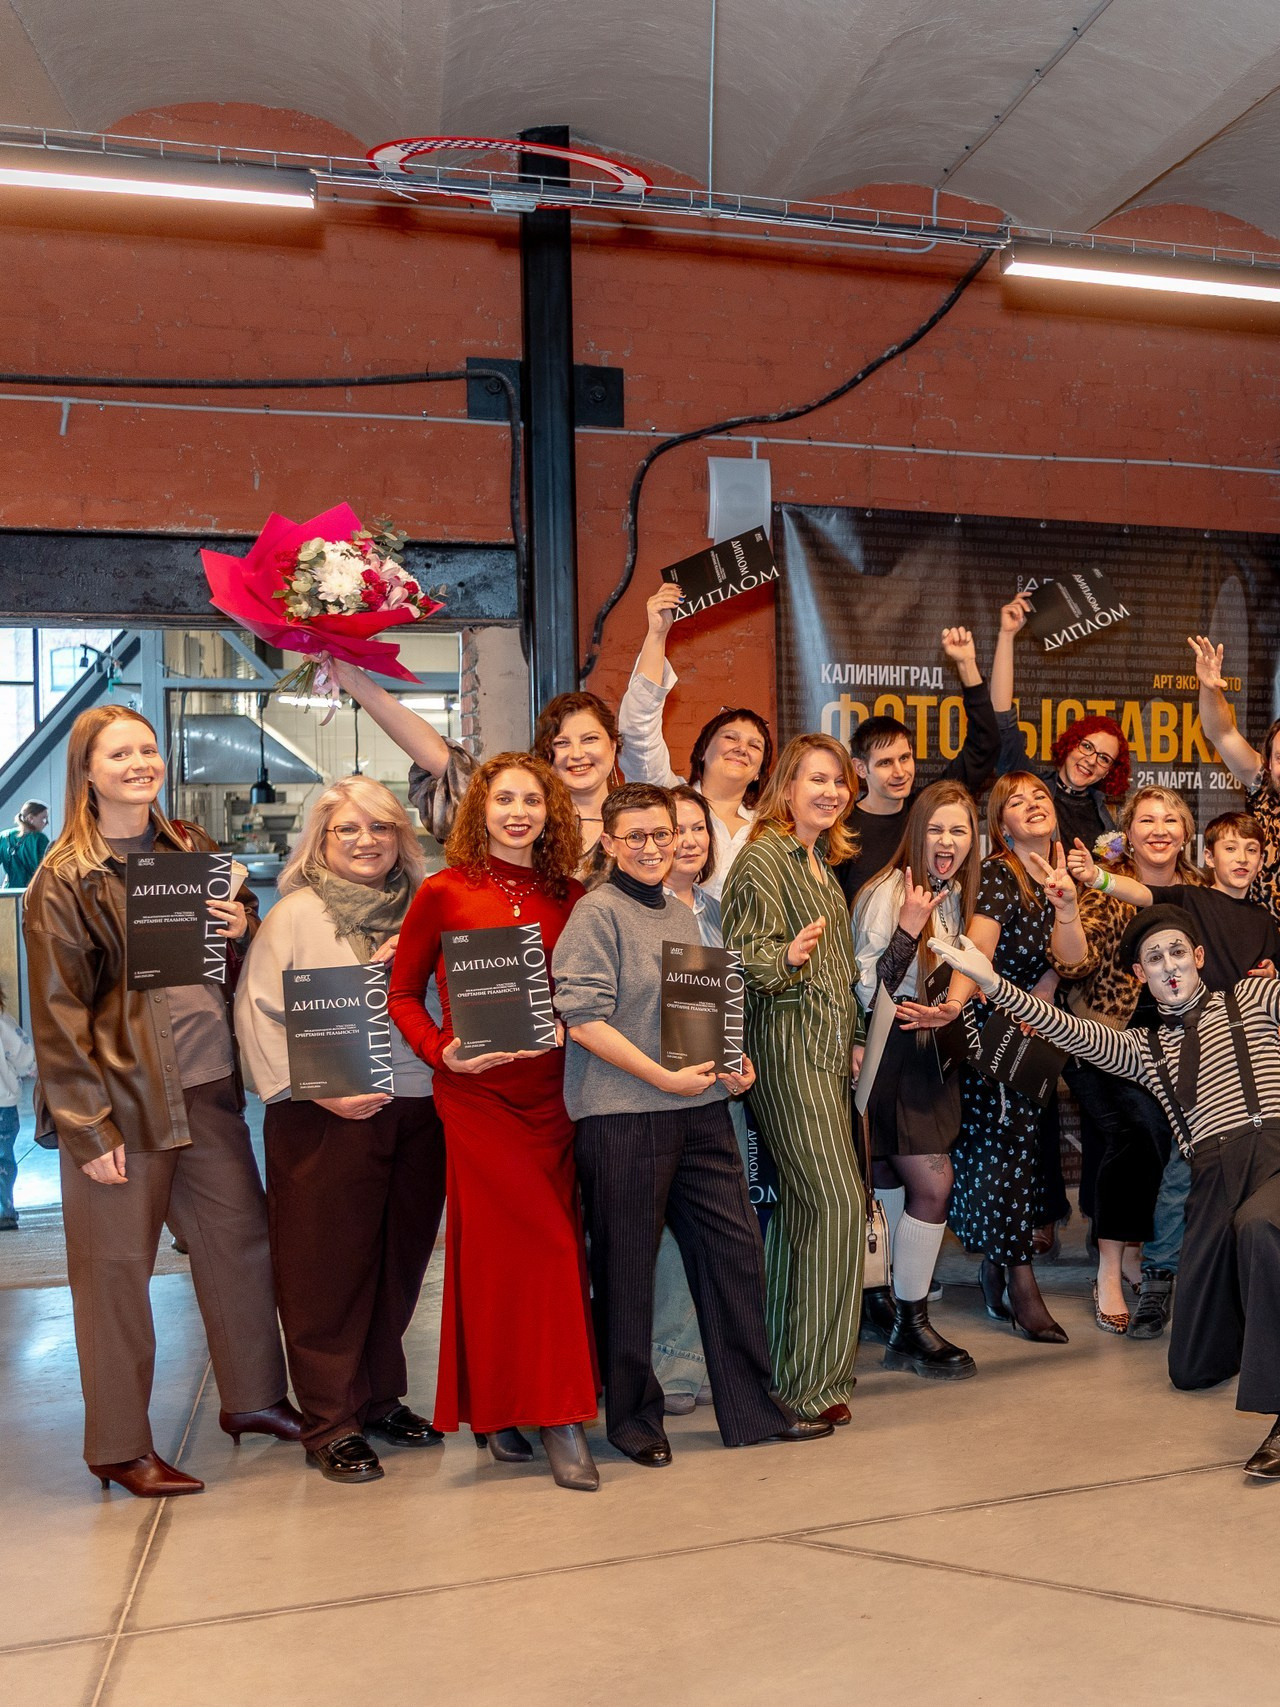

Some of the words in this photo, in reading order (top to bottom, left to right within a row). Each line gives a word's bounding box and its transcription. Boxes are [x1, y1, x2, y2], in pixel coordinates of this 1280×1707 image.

[731, 540, 750, 576] ДИПЛОМ
[673, 565, 780, 623] ДИПЛОМ
[1072, 573, 1101, 612] ДИПЛОМ
[1043, 602, 1131, 652] ДИПЛОМ
[821, 663, 944, 690] КАЛИНИНГРАД
[1153, 674, 1174, 689] АРТ
[1157, 771, 1203, 790] МАРТА
[132, 884, 202, 897] ДИПЛОМ
[203, 852, 233, 983] ДИПОМ
[452, 956, 520, 972] ДИПЛОМ
[666, 972, 721, 988] ДИПЛОМ
[519, 922, 559, 1047] ДИПЛОМ
[291, 997, 360, 1012] ДИПЛОМ
[723, 950, 745, 1075] ДИПЛОМ
[363, 962, 395, 1093] ДИПЛОМ
[989, 1025, 1017, 1074] ДИПЛОМ
[747, 1128, 759, 1182] ДИПЛОМ
